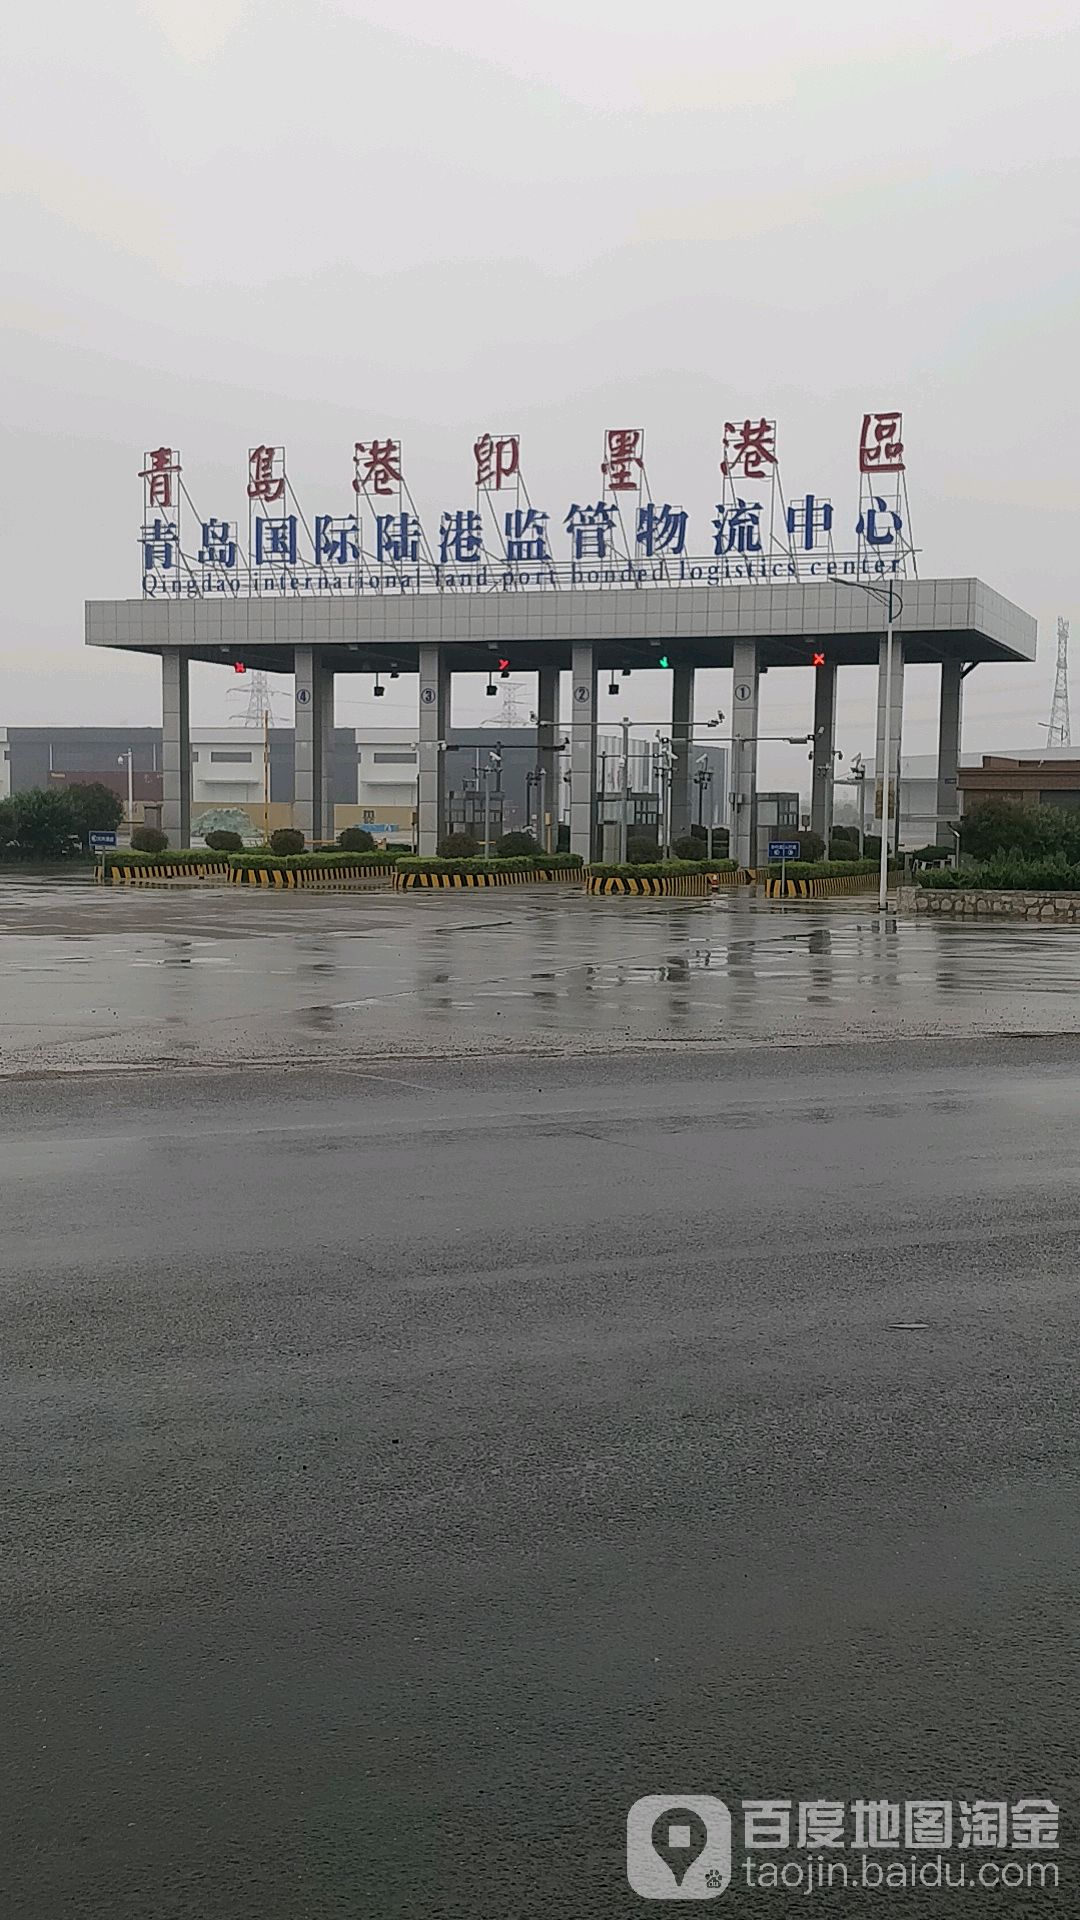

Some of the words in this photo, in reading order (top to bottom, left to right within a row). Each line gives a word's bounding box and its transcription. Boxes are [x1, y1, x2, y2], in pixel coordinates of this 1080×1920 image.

[137, 495, 903, 570] 青岛国际陆港监管物流中心
[141, 573, 240, 598] Qingdao
[253, 567, 420, 590] international
[435, 565, 488, 588] land
[502, 569, 557, 592] port
[571, 560, 664, 584] bonded
[679, 560, 796, 585] logistics
[811, 558, 899, 576] center
